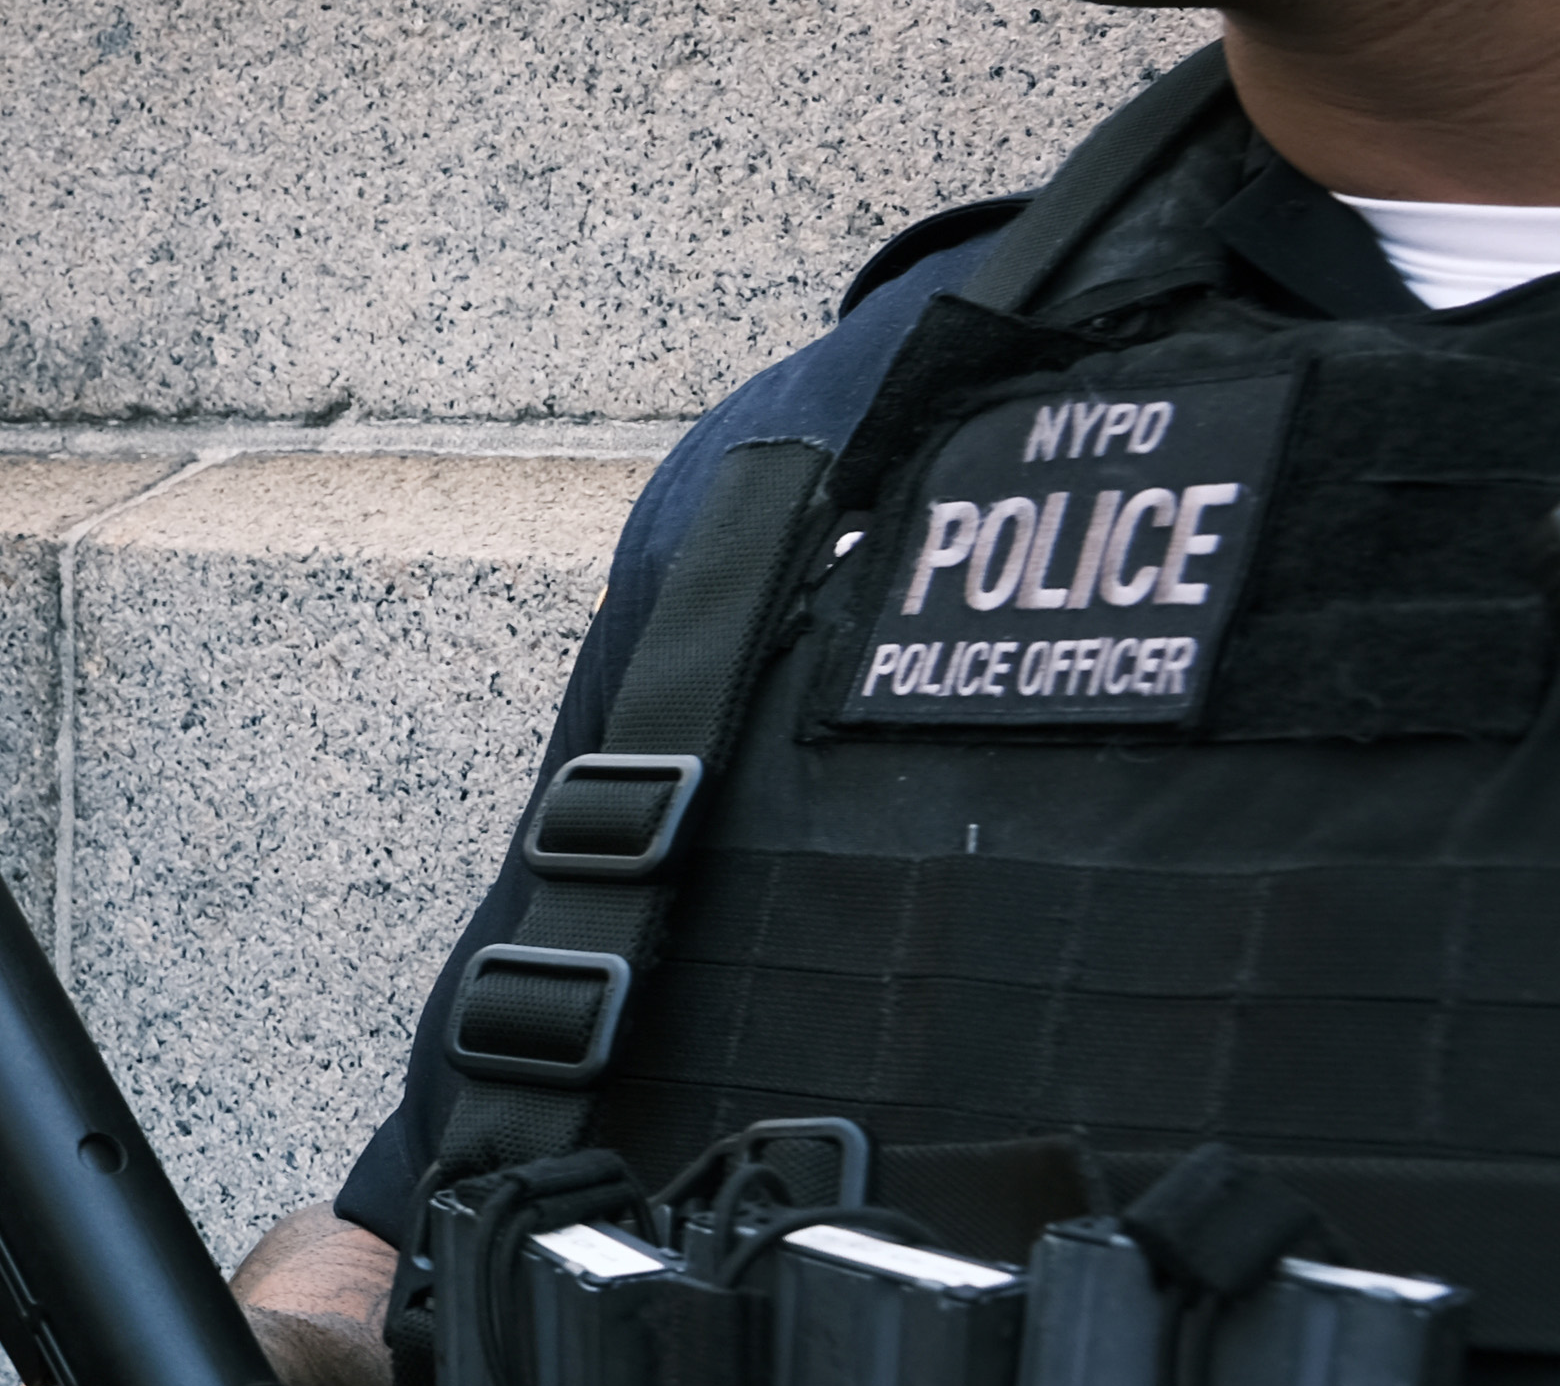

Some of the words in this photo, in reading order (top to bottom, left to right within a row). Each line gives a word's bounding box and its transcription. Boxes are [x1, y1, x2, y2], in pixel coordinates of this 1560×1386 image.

[1024, 401, 1174, 462] NYPD
[900, 482, 1245, 616] POLICE
[860, 641, 1020, 697] POLICE
[1017, 637, 1197, 697] OFFICER
